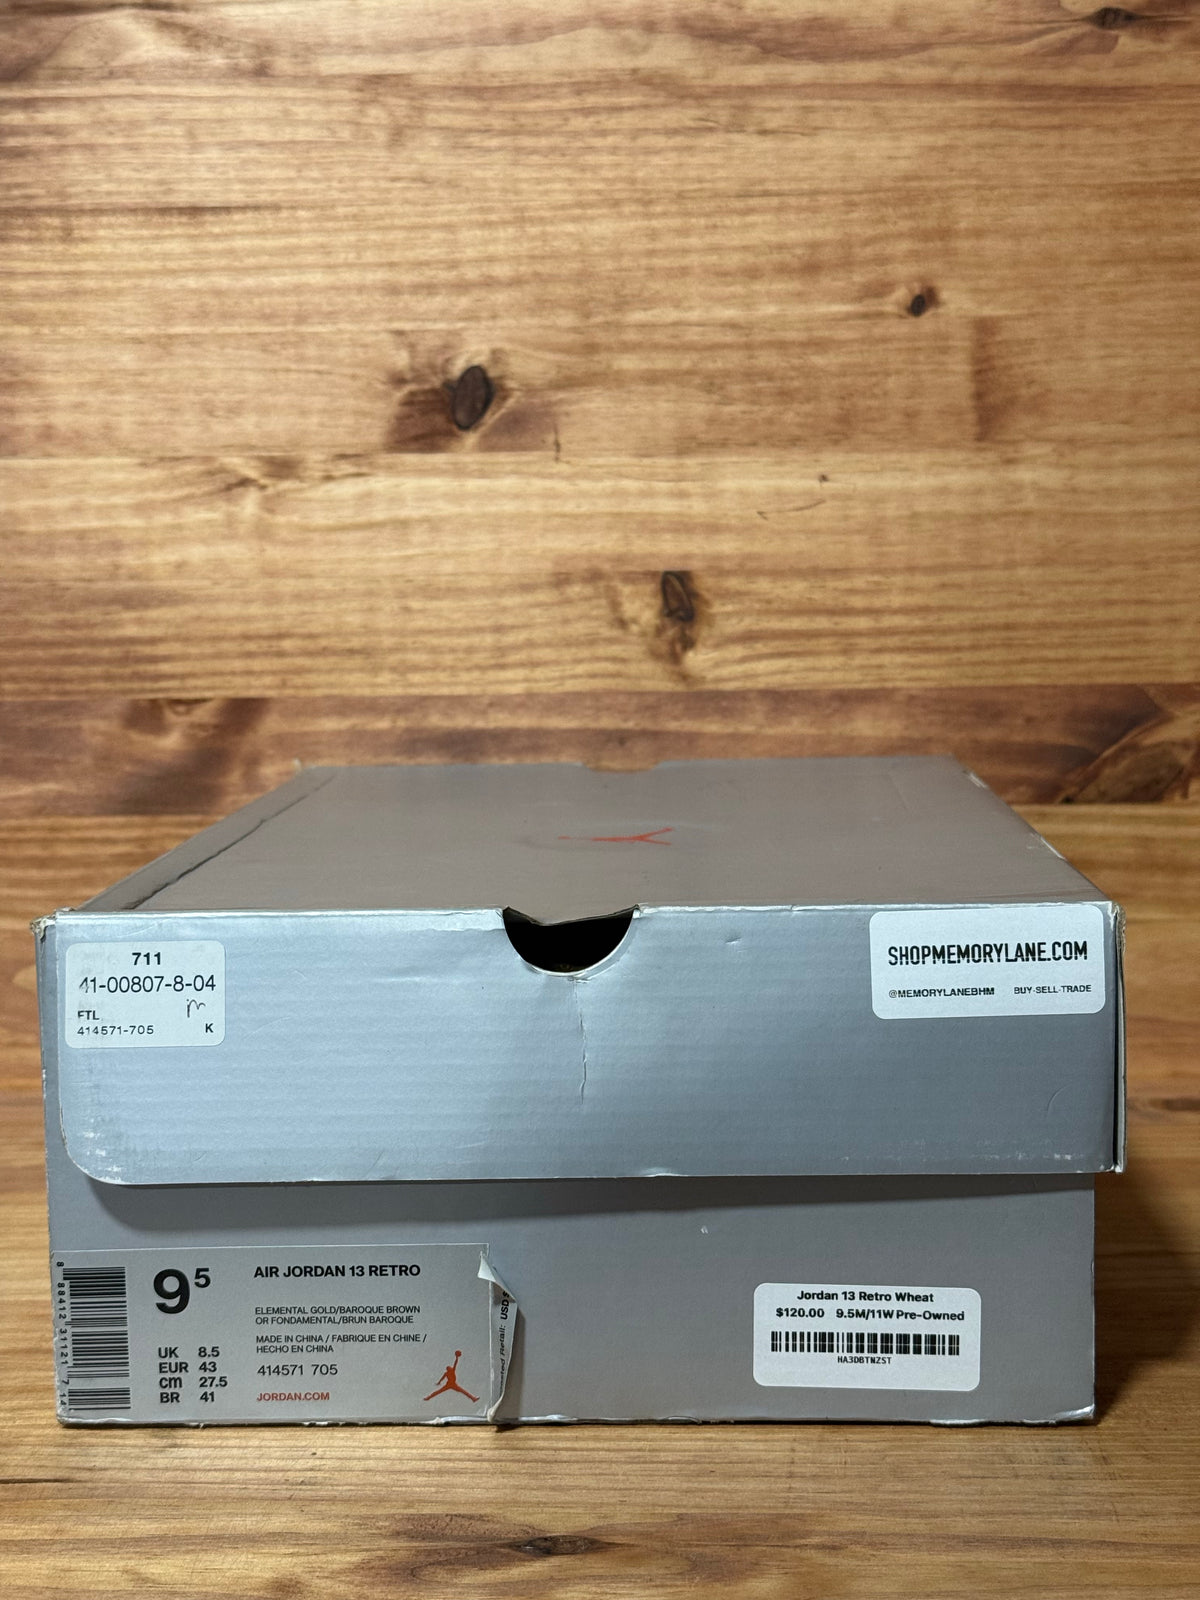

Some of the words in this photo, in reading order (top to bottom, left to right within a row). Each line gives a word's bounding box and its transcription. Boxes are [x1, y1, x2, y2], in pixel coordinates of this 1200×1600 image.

[132, 952, 162, 966] 711
[888, 941, 1088, 966] SHOPMEMORYLANE.COM
[78, 975, 216, 994] 41-00807-8-04
[889, 987, 995, 999] @MEMORYLANEBHM
[1014, 985, 1092, 995] BUY-SELL-TRADE
[77, 1010, 100, 1021] FTL
[77, 1025, 154, 1035] 414571-705
[205, 1023, 214, 1033] K
[254, 1266, 280, 1278] AIR
[283, 1265, 346, 1278] JORDAN
[349, 1265, 365, 1277] 13
[368, 1264, 421, 1277] RETRO
[153, 1268, 190, 1314] 9
[194, 1268, 211, 1288] 5
[797, 1290, 838, 1300] Jordan
[841, 1291, 855, 1301] 13
[859, 1292, 892, 1302] Retro
[895, 1292, 934, 1303] Wheat
[255, 1306, 308, 1315] ELEMENTAL
[310, 1306, 384, 1314] GOLD/BAROQUE
[500, 1298, 510, 1320] USD
[776, 1307, 825, 1318] $120.00
[836, 1309, 894, 1320] 9.5M/11W
[896, 1310, 965, 1321] Pre-Owned
[255, 1316, 269, 1325] OR
[271, 1316, 367, 1325] FONDAMENTAL/BRUN
[369, 1315, 414, 1324] BAROQUE
[256, 1335, 282, 1343] MADE
[284, 1335, 294, 1343] IN
[295, 1335, 323, 1343] CHINA
[325, 1335, 330, 1343] /
[331, 1334, 376, 1343] FABRIQUE
[378, 1334, 391, 1342] EN
[392, 1334, 421, 1342] CHINE
[422, 1334, 427, 1342] /
[158, 1347, 179, 1358] UK
[198, 1346, 220, 1358] 8.5
[256, 1345, 289, 1353] HECHO
[291, 1345, 304, 1353] EN
[305, 1345, 334, 1353] CHINA
[159, 1362, 189, 1374] EUR
[199, 1361, 217, 1372] 43
[257, 1364, 304, 1376] 414571
[311, 1364, 338, 1375] 705
[159, 1377, 183, 1389] cm
[199, 1376, 228, 1388] 27.5
[160, 1392, 180, 1404] BR
[200, 1391, 215, 1402] 41
[257, 1391, 330, 1401] JORDAN.COM
